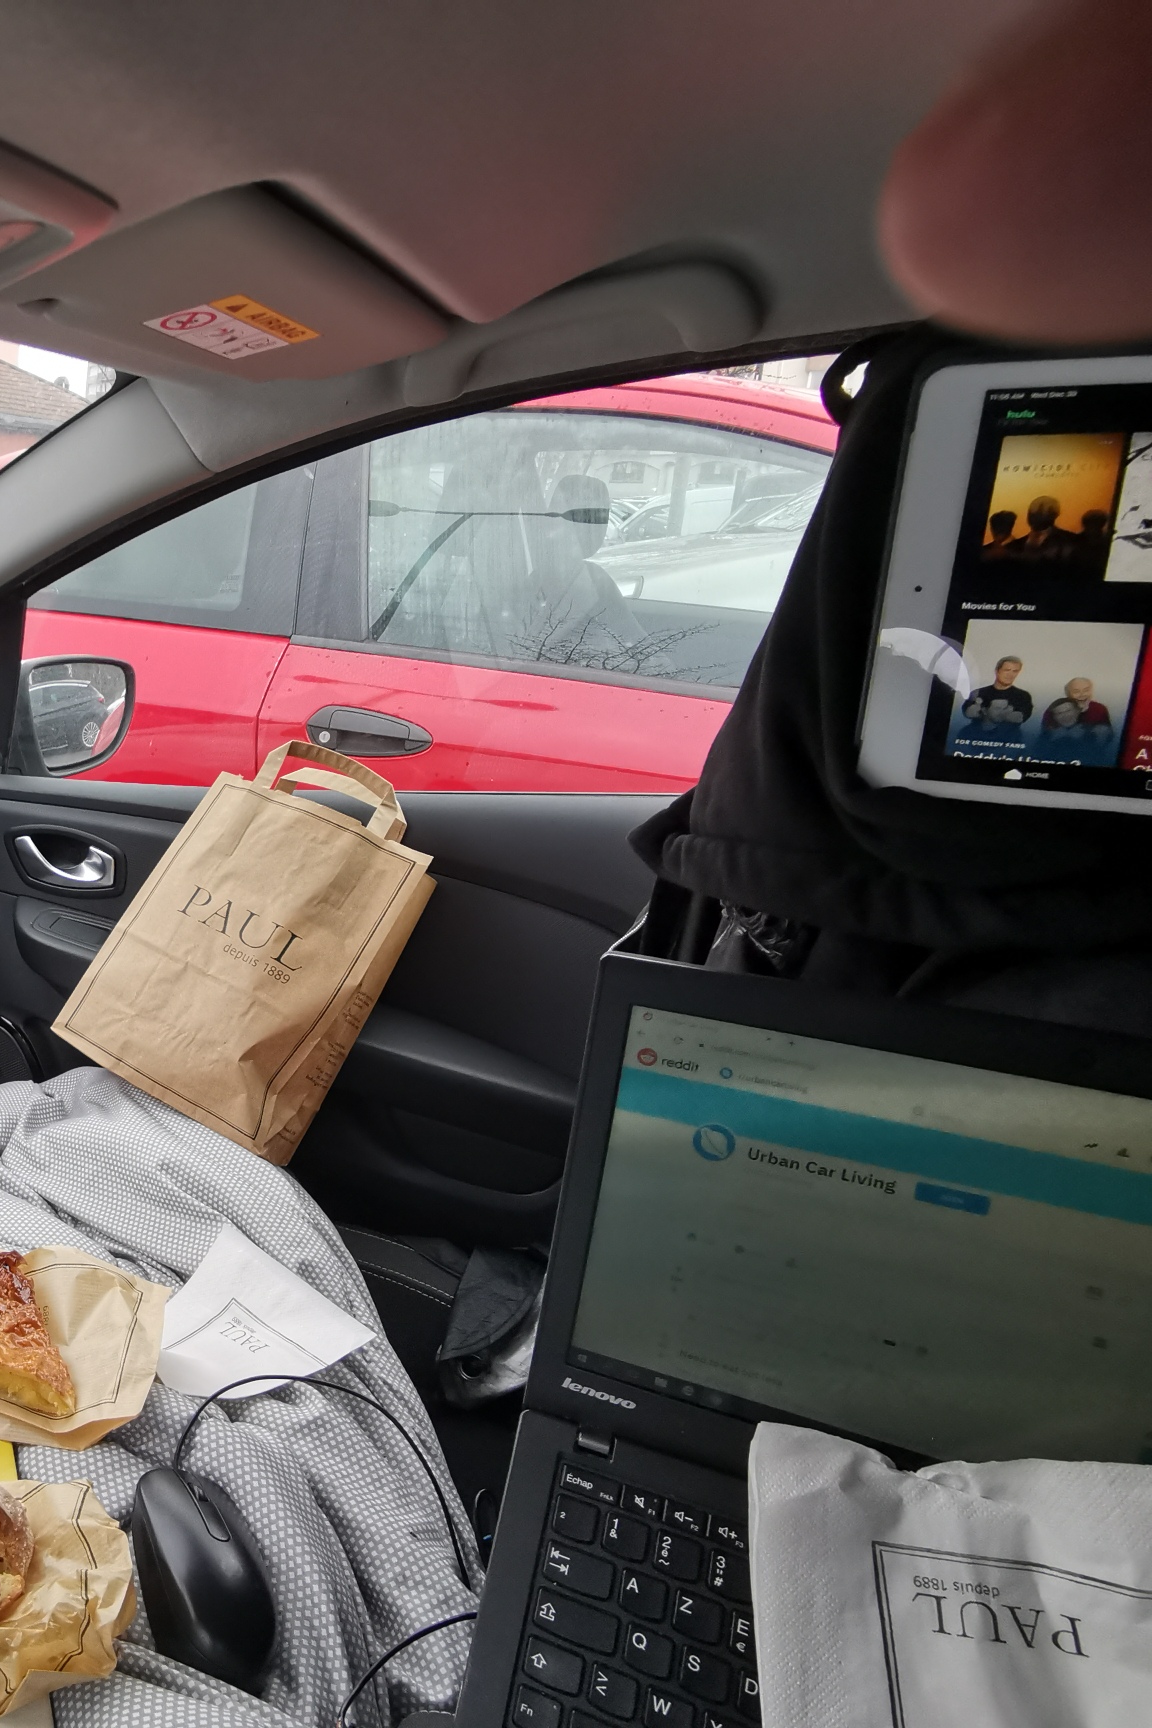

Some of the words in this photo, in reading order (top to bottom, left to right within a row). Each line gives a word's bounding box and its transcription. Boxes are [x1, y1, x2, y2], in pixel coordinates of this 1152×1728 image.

[1006, 409, 1036, 420] hulu
[961, 602, 997, 611] Movies
[999, 602, 1014, 611] for
[1016, 603, 1037, 612] You
[955, 738, 971, 746] FOR
[177, 884, 303, 971] PAUL
[223, 944, 260, 967] depuis
[262, 962, 291, 985] 1889
[661, 1058, 699, 1073] reddit
[748, 1147, 800, 1170] Urban
[806, 1160, 836, 1178] Car
[841, 1169, 898, 1195] Living
[219, 1321, 270, 1354] PAUL
[561, 1377, 636, 1409] lenovo
[566, 1472, 593, 1490] Échap
[648, 1508, 656, 1516] F1
[613, 1518, 619, 1529] 1
[690, 1524, 699, 1532] F2
[662, 1536, 672, 1548] 2
[716, 1556, 726, 1568] 3
[626, 1577, 639, 1593] A
[913, 1575, 948, 1591] 1889
[952, 1581, 1000, 1598] depuis
[679, 1596, 693, 1614] Z
[737, 1619, 750, 1636] E
[912, 1592, 1089, 1658] PAUL
[632, 1633, 647, 1650] Q
[688, 1655, 701, 1672] S
[745, 1678, 758, 1695] D
[520, 1703, 533, 1717] Fn
[652, 1695, 672, 1716] W
